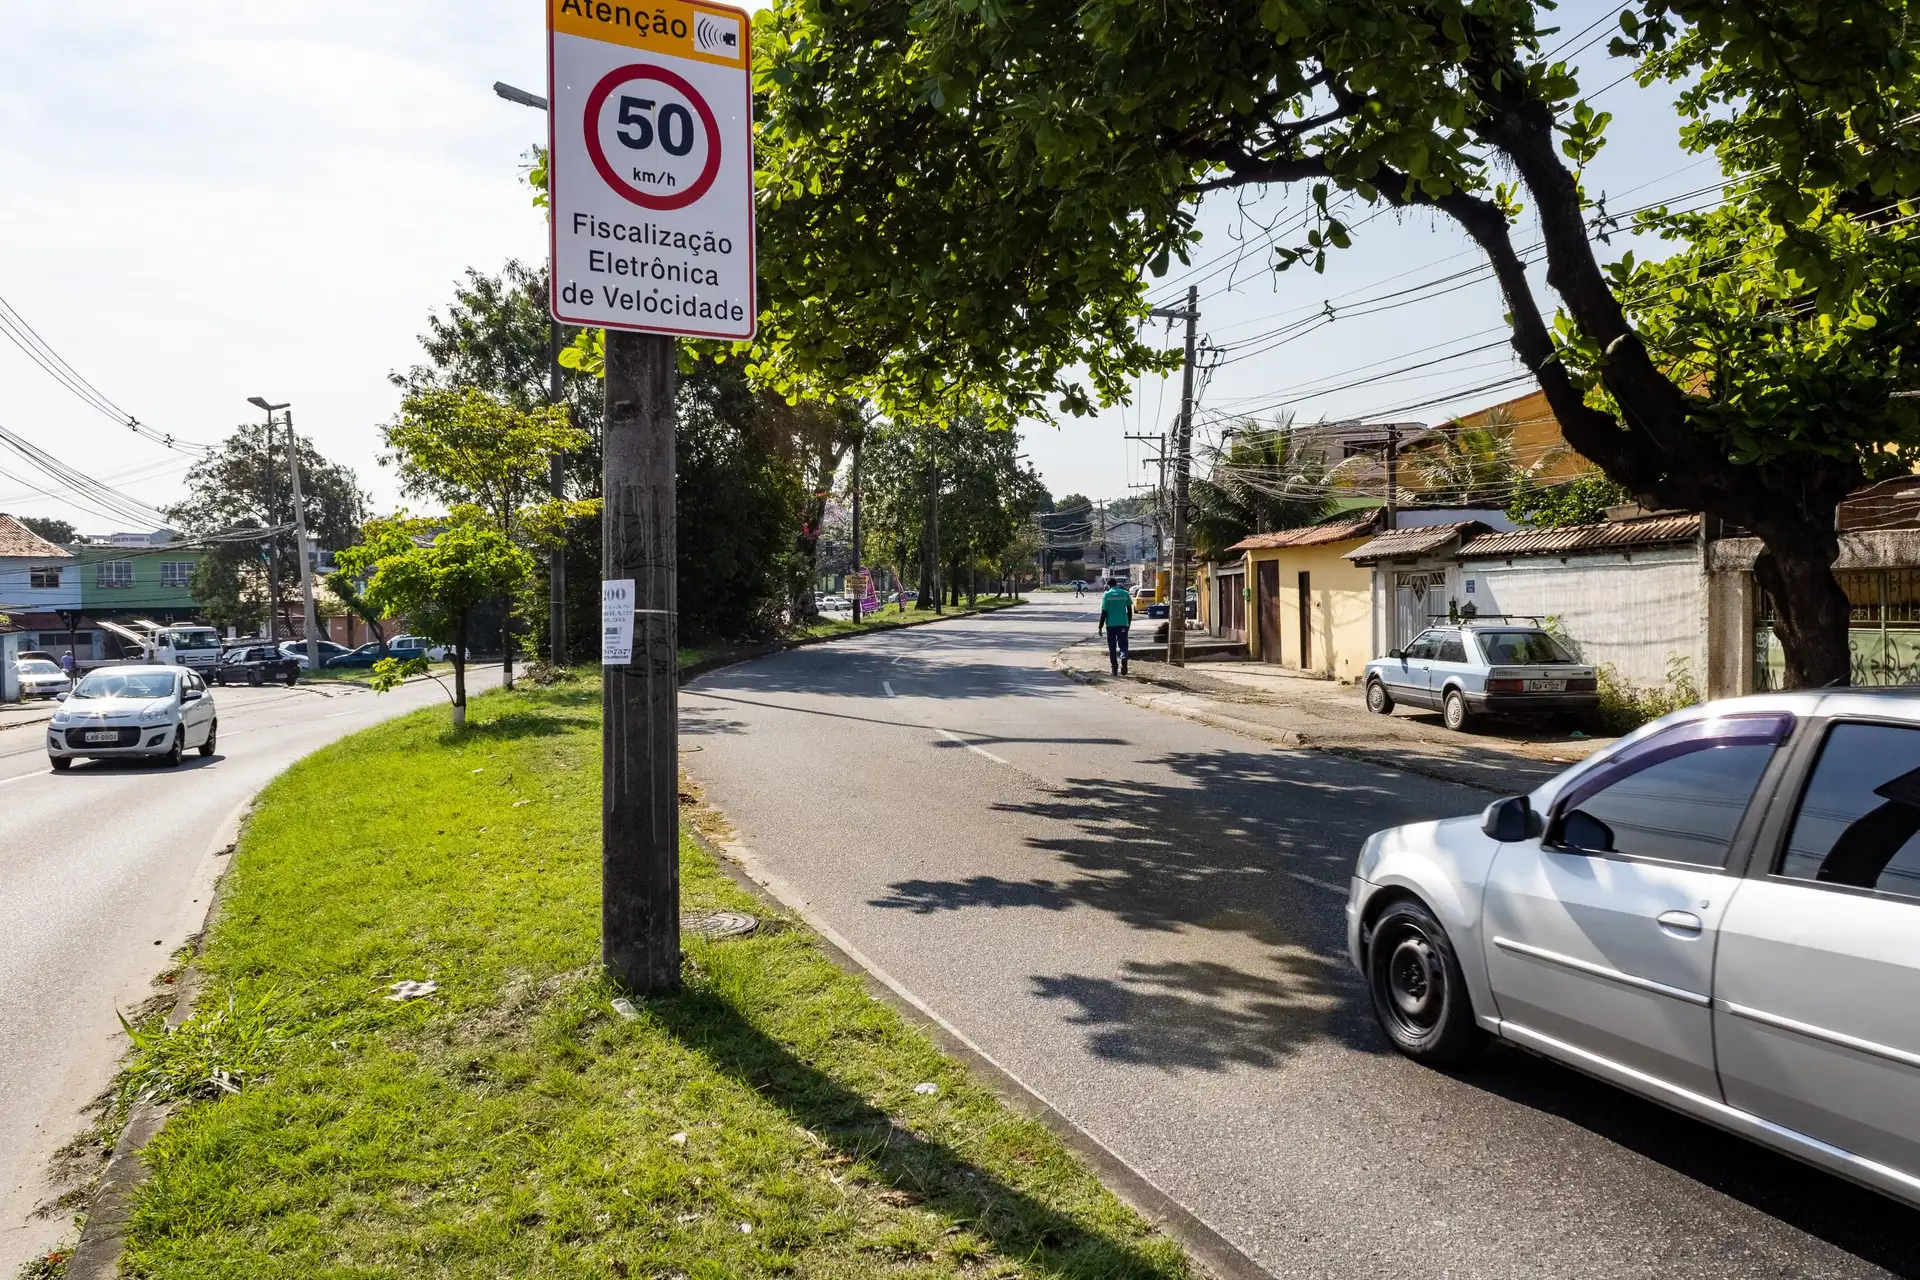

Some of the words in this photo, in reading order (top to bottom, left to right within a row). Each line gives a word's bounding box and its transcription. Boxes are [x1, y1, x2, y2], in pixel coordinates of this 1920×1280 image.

[560, 0, 687, 38] Atenção
[616, 95, 694, 157] 50
[633, 167, 676, 187] km/h
[573, 212, 732, 256] Fiscalização
[589, 250, 719, 287] Eletrônica
[562, 283, 594, 306] de
[603, 286, 744, 321] Velocidade
